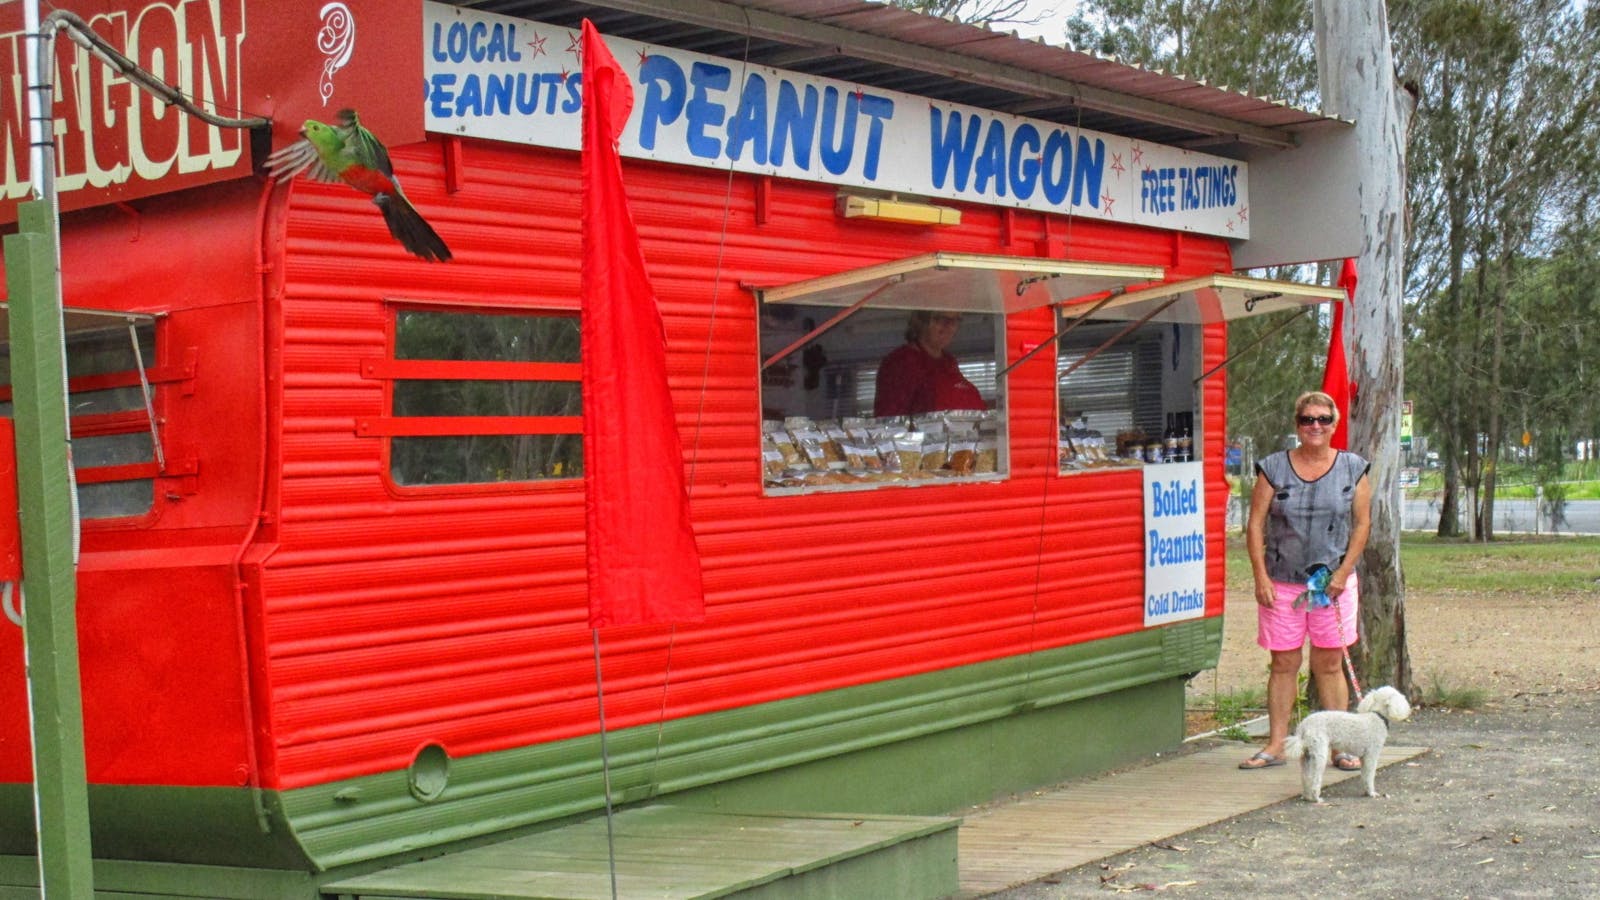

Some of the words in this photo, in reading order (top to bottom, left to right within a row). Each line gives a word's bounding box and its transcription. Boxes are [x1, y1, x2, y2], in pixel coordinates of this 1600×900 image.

[432, 21, 521, 63] LOCAL
[639, 54, 894, 181] PEANUT
[930, 106, 1105, 209] WAGON
[1141, 168, 1175, 215] FREE
[1179, 165, 1237, 211] TASTINGS
[1152, 480, 1198, 518] Boiled
[1149, 529, 1203, 567] Peanuts
[1148, 594, 1169, 617] Cold
[1172, 589, 1203, 614] Drinks
